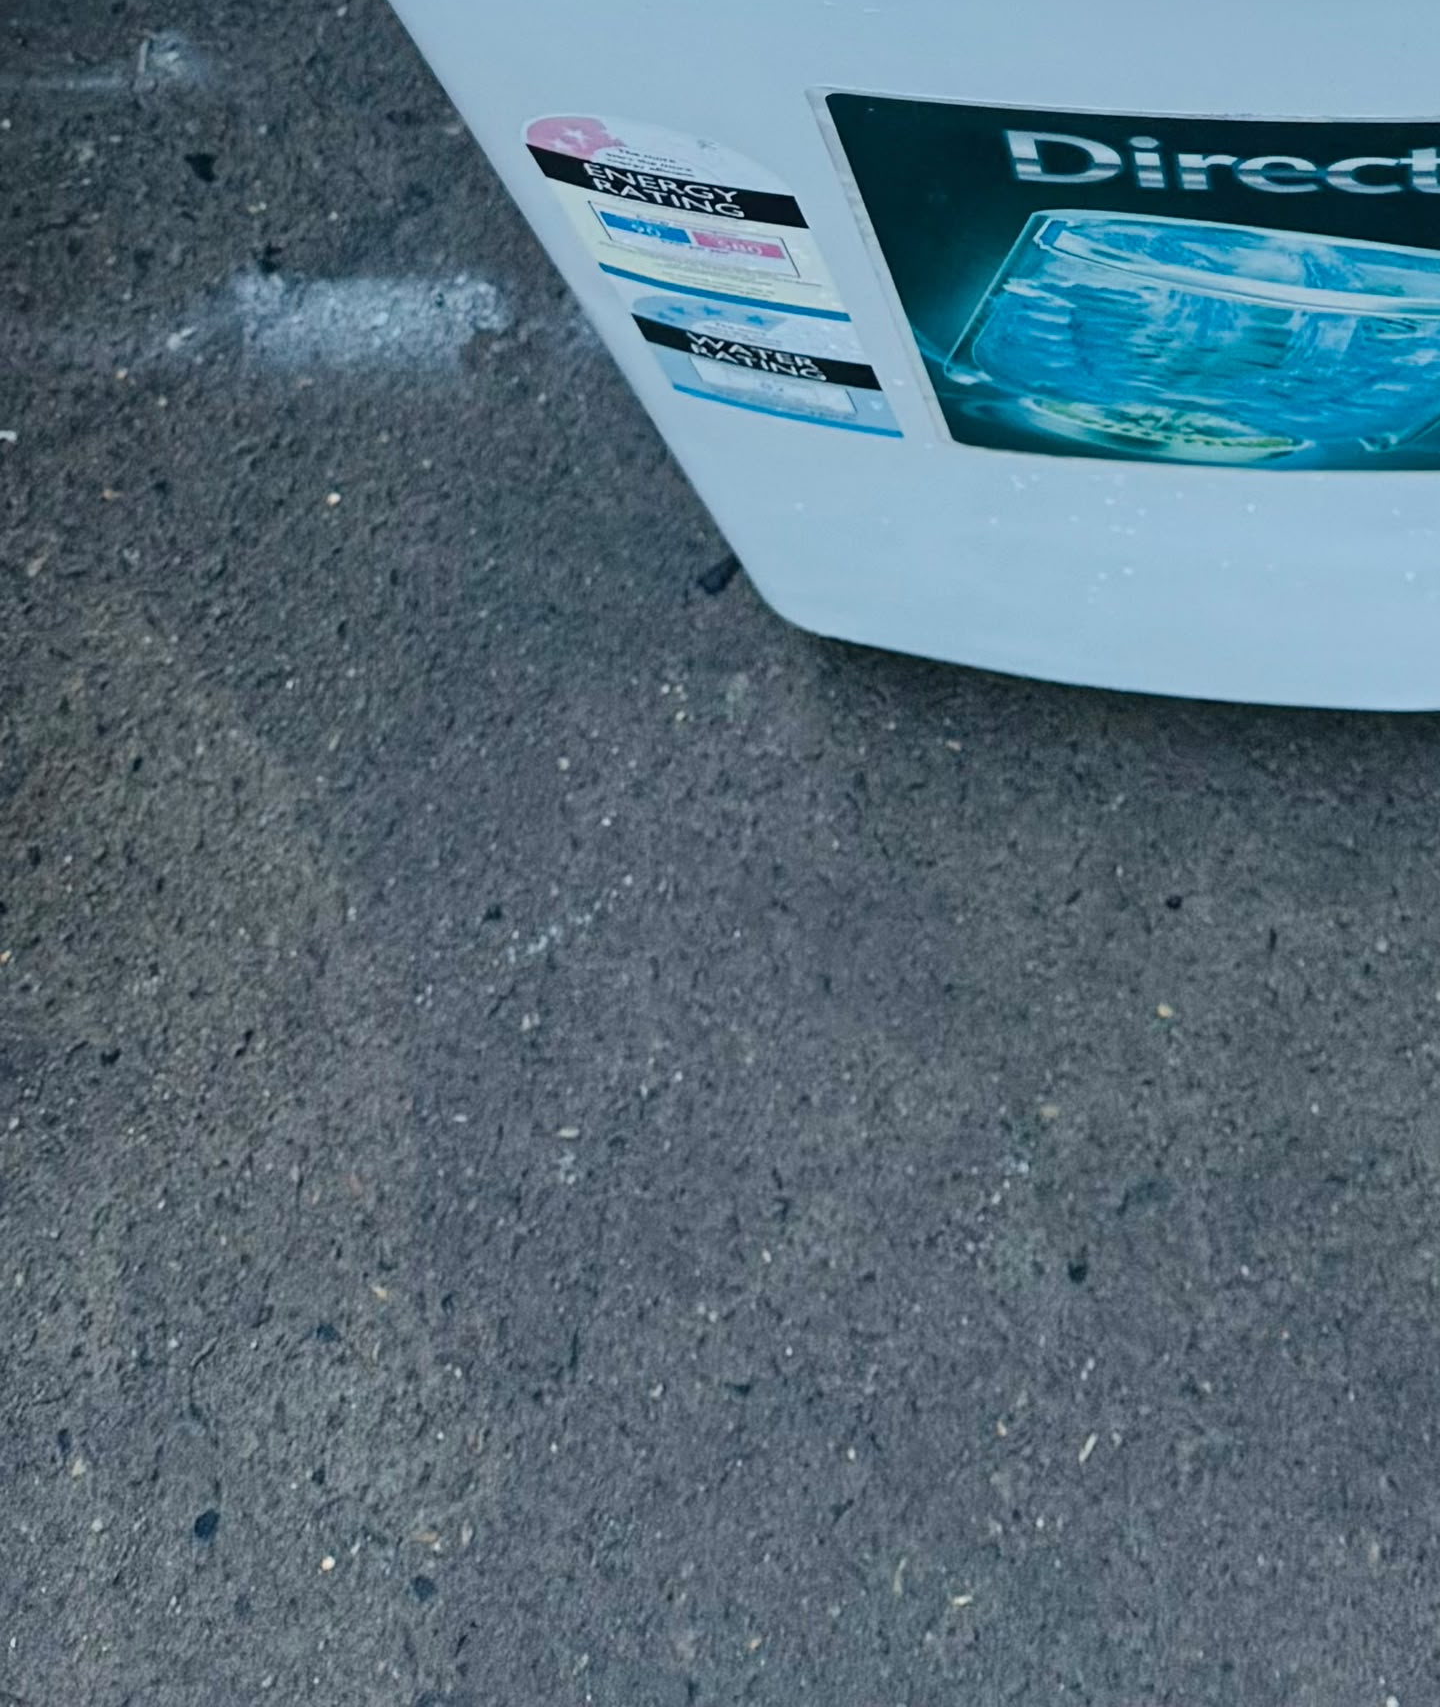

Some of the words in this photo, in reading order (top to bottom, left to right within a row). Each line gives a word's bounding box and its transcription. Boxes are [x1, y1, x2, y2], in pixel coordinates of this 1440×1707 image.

[583, 162, 738, 203] ENERGY
[593, 178, 745, 218] RATING
[686, 331, 824, 372] WATER
[691, 343, 827, 382] RATING
